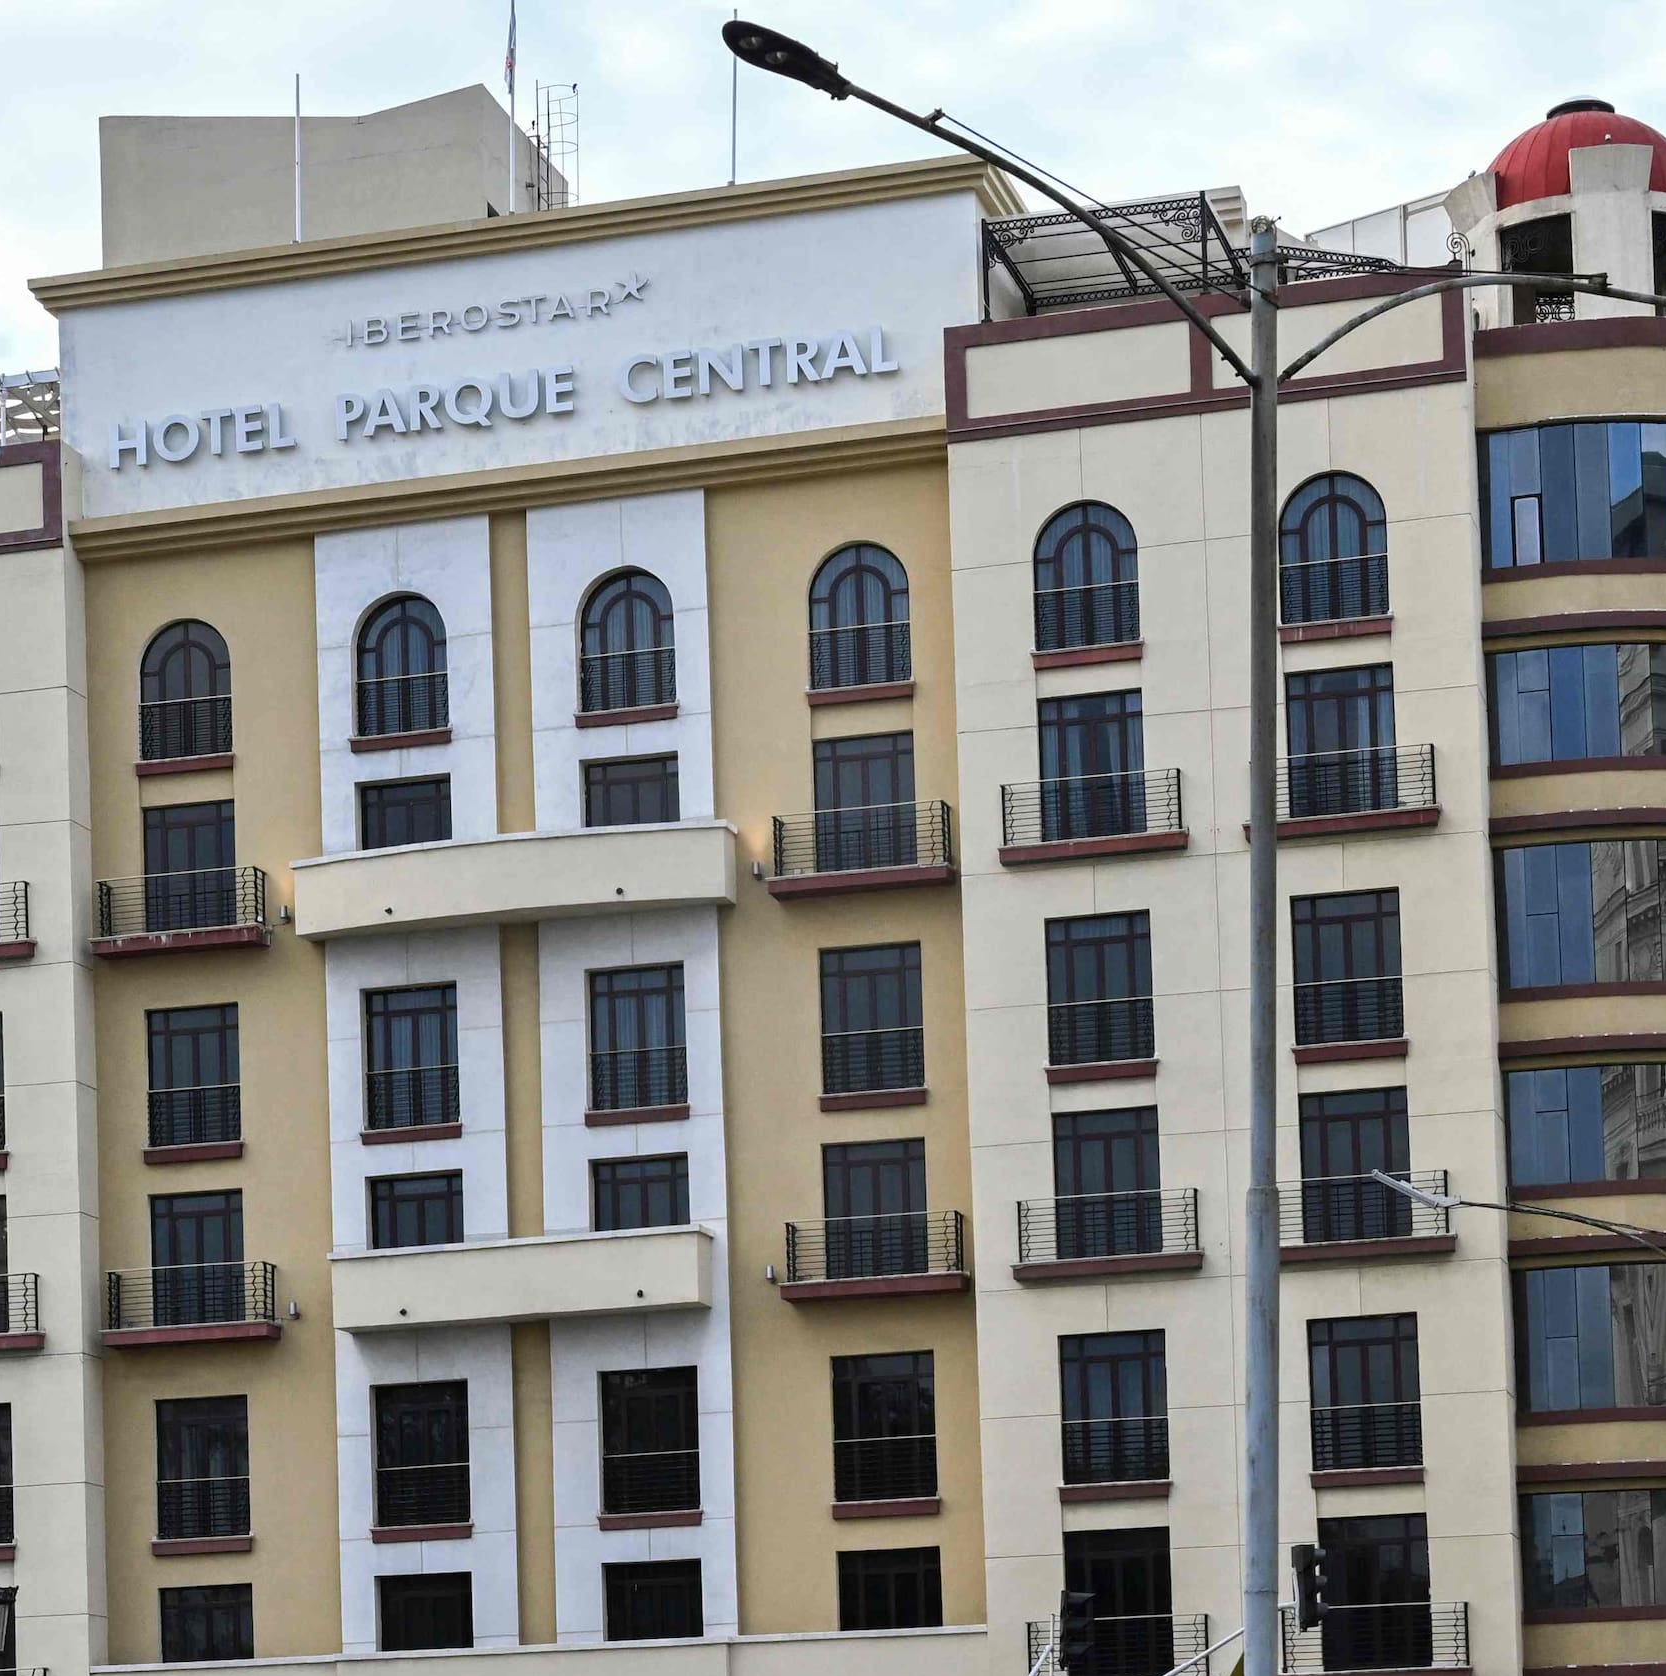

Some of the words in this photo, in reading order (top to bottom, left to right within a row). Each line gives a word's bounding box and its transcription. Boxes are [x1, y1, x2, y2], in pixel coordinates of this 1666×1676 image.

[345, 287, 612, 347] IBEROSTAR
[108, 402, 297, 470] HOTEL
[334, 364, 575, 442] PARQUE
[619, 324, 900, 405] CENTRAL
